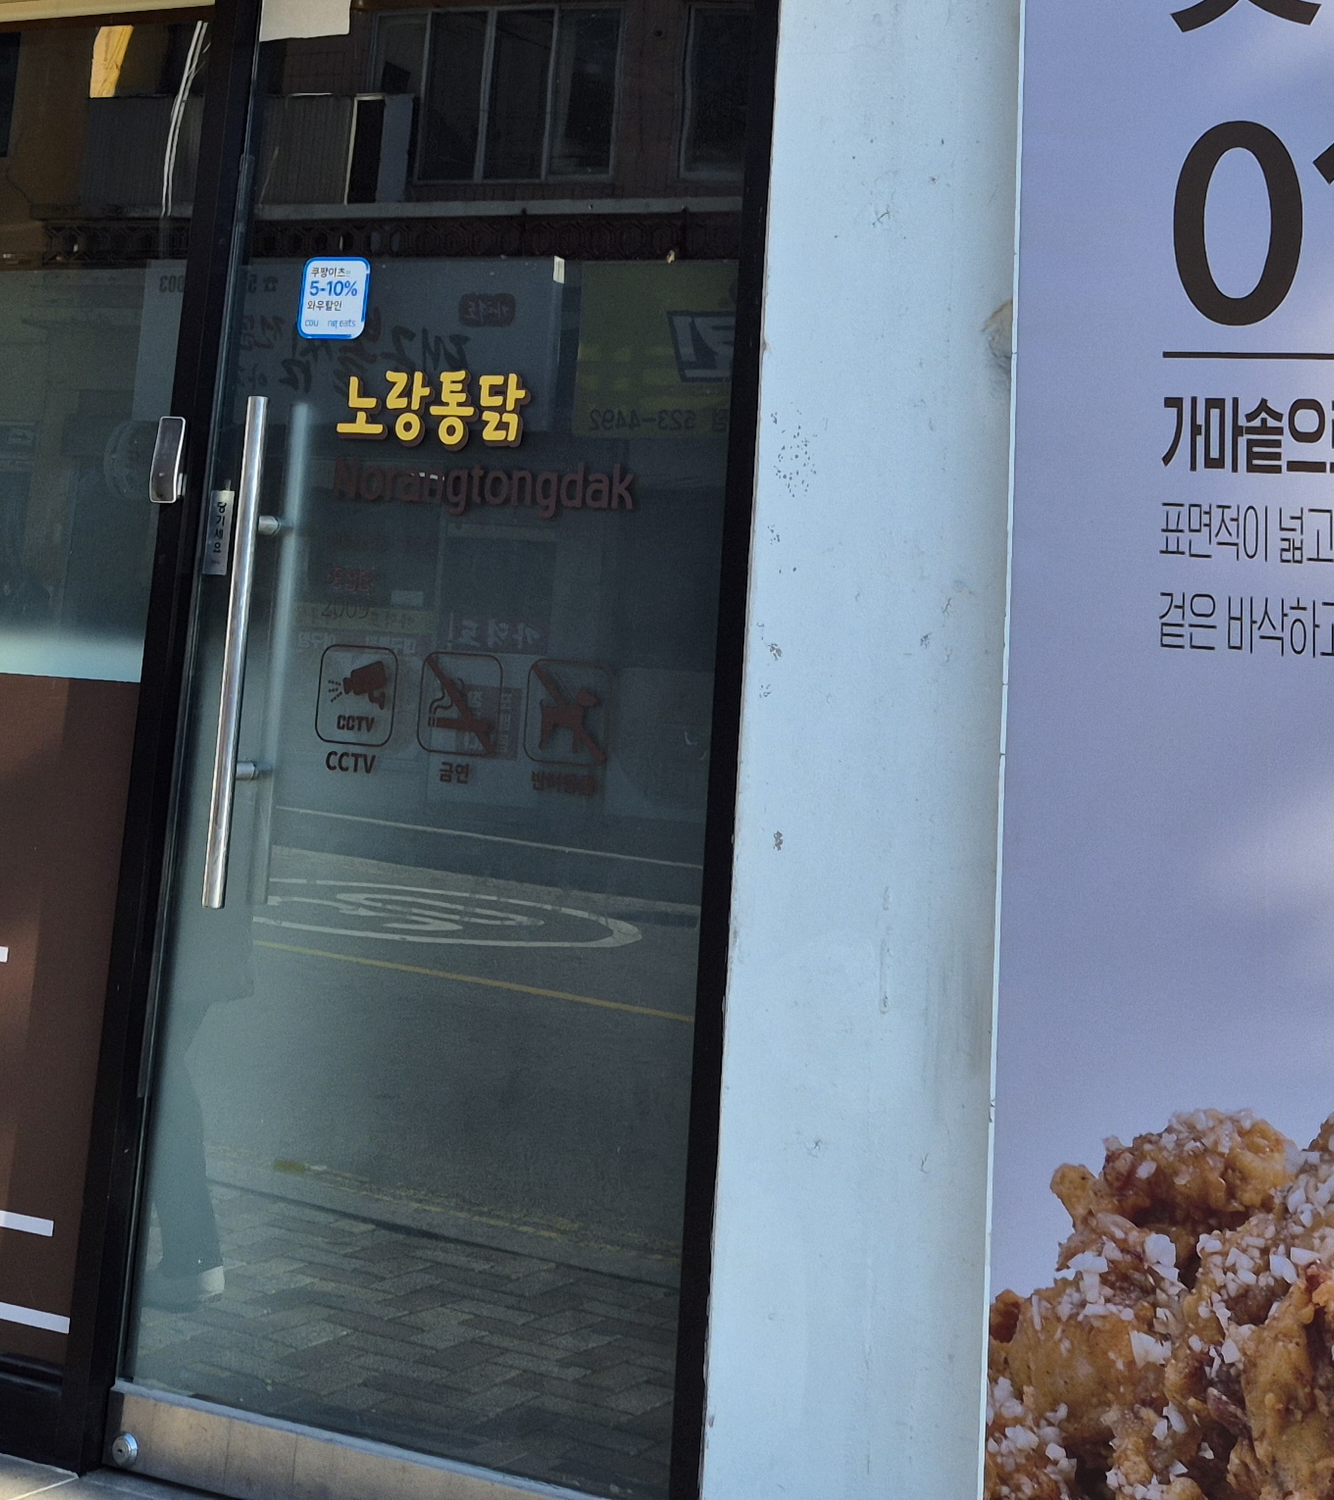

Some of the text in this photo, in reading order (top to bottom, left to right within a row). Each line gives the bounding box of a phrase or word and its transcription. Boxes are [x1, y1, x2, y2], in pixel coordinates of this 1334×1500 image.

[311, 267, 351, 278] 쿠팡이츠
[309, 280, 358, 297] 5-10%
[307, 300, 342, 311] 와우할인
[336, 370, 530, 447] 노랑통닭
[333, 457, 634, 519] Norangtongdak
[212, 502, 227, 553] 당기세요
[1159, 501, 1269, 563] 표면적이
[1158, 592, 1217, 652] 겉은
[337, 714, 375, 732] CCTV
[325, 750, 376, 774] CCTV
[439, 761, 469, 785] 금연
